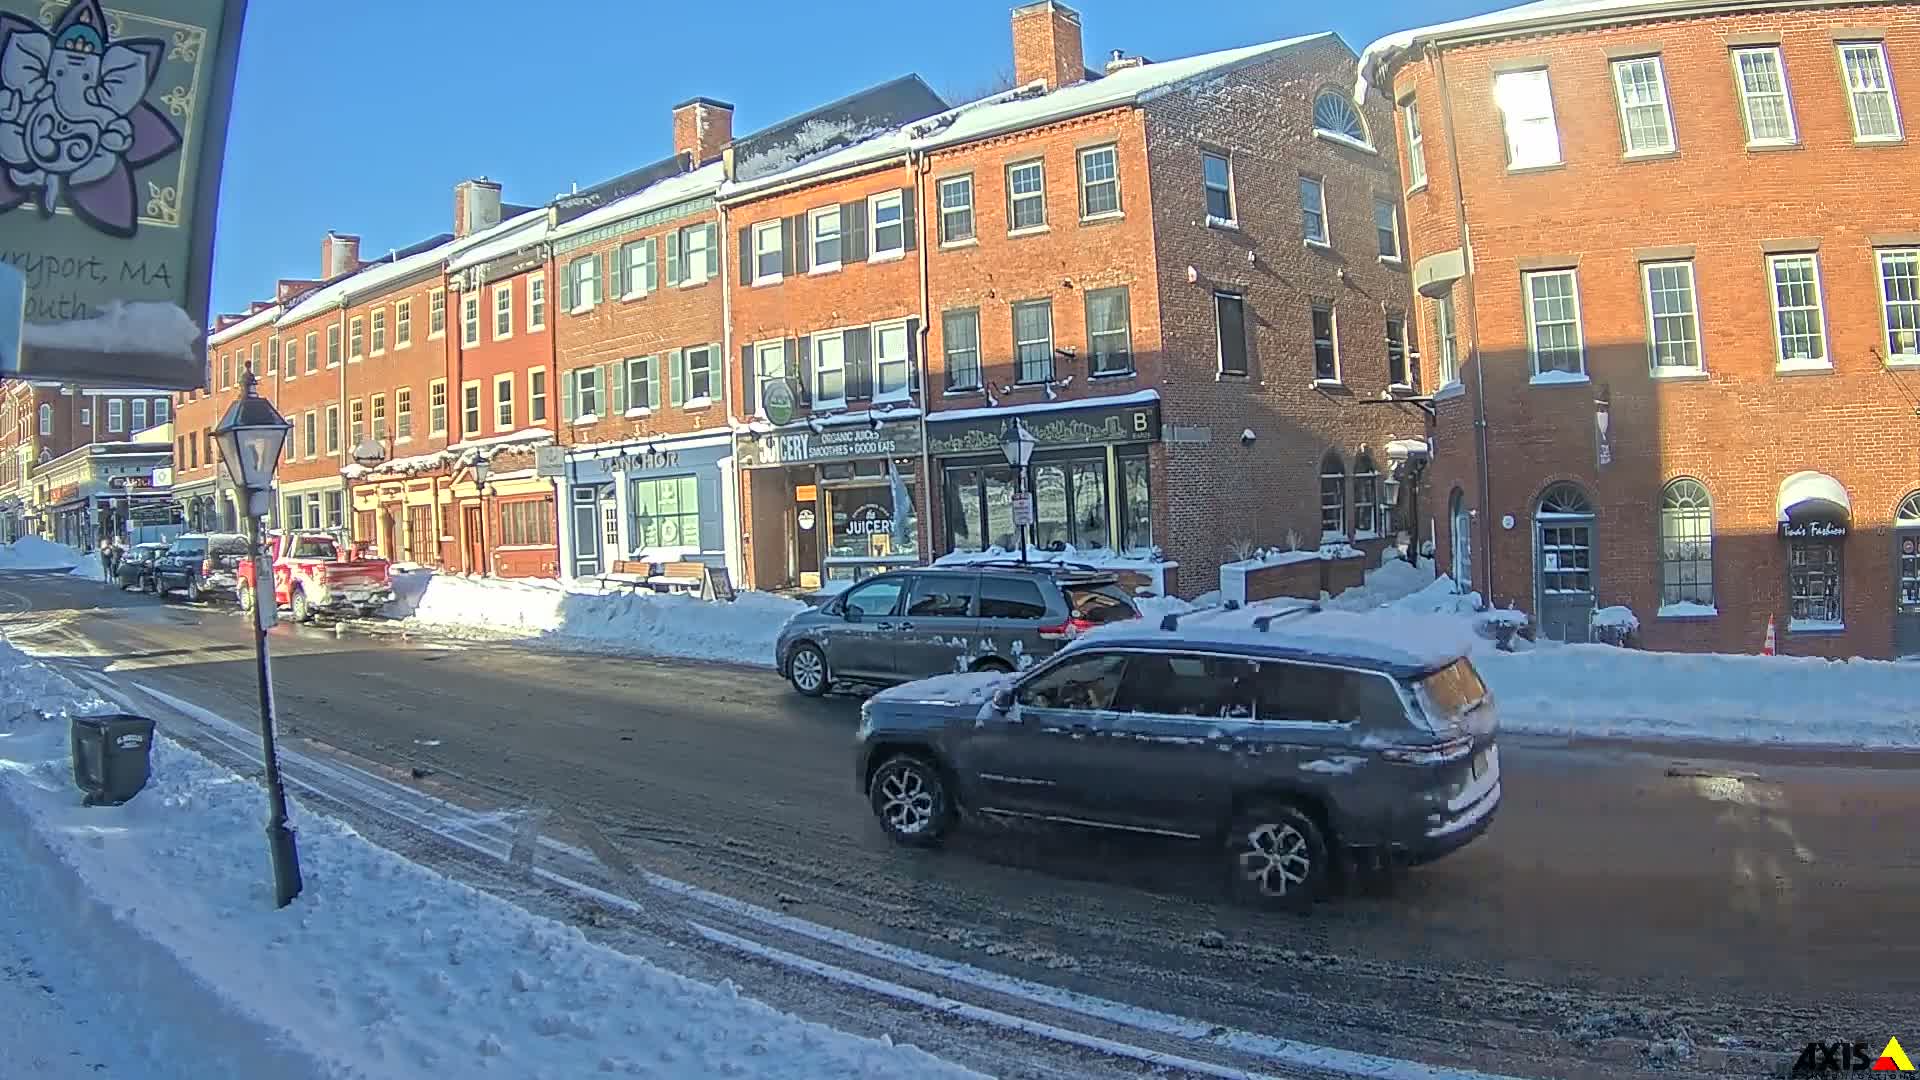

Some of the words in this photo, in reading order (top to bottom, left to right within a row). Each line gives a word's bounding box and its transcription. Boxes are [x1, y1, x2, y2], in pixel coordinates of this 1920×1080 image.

[0, 251, 107, 289] ryport,
[120, 260, 173, 288] MA
[1134, 412, 1148, 431] B
[822, 431, 853, 444] ORGANIC
[808, 444, 848, 458] SMOOTHIES
[854, 442, 877, 454] GOOD
[846, 519, 896, 535] JUICERY
